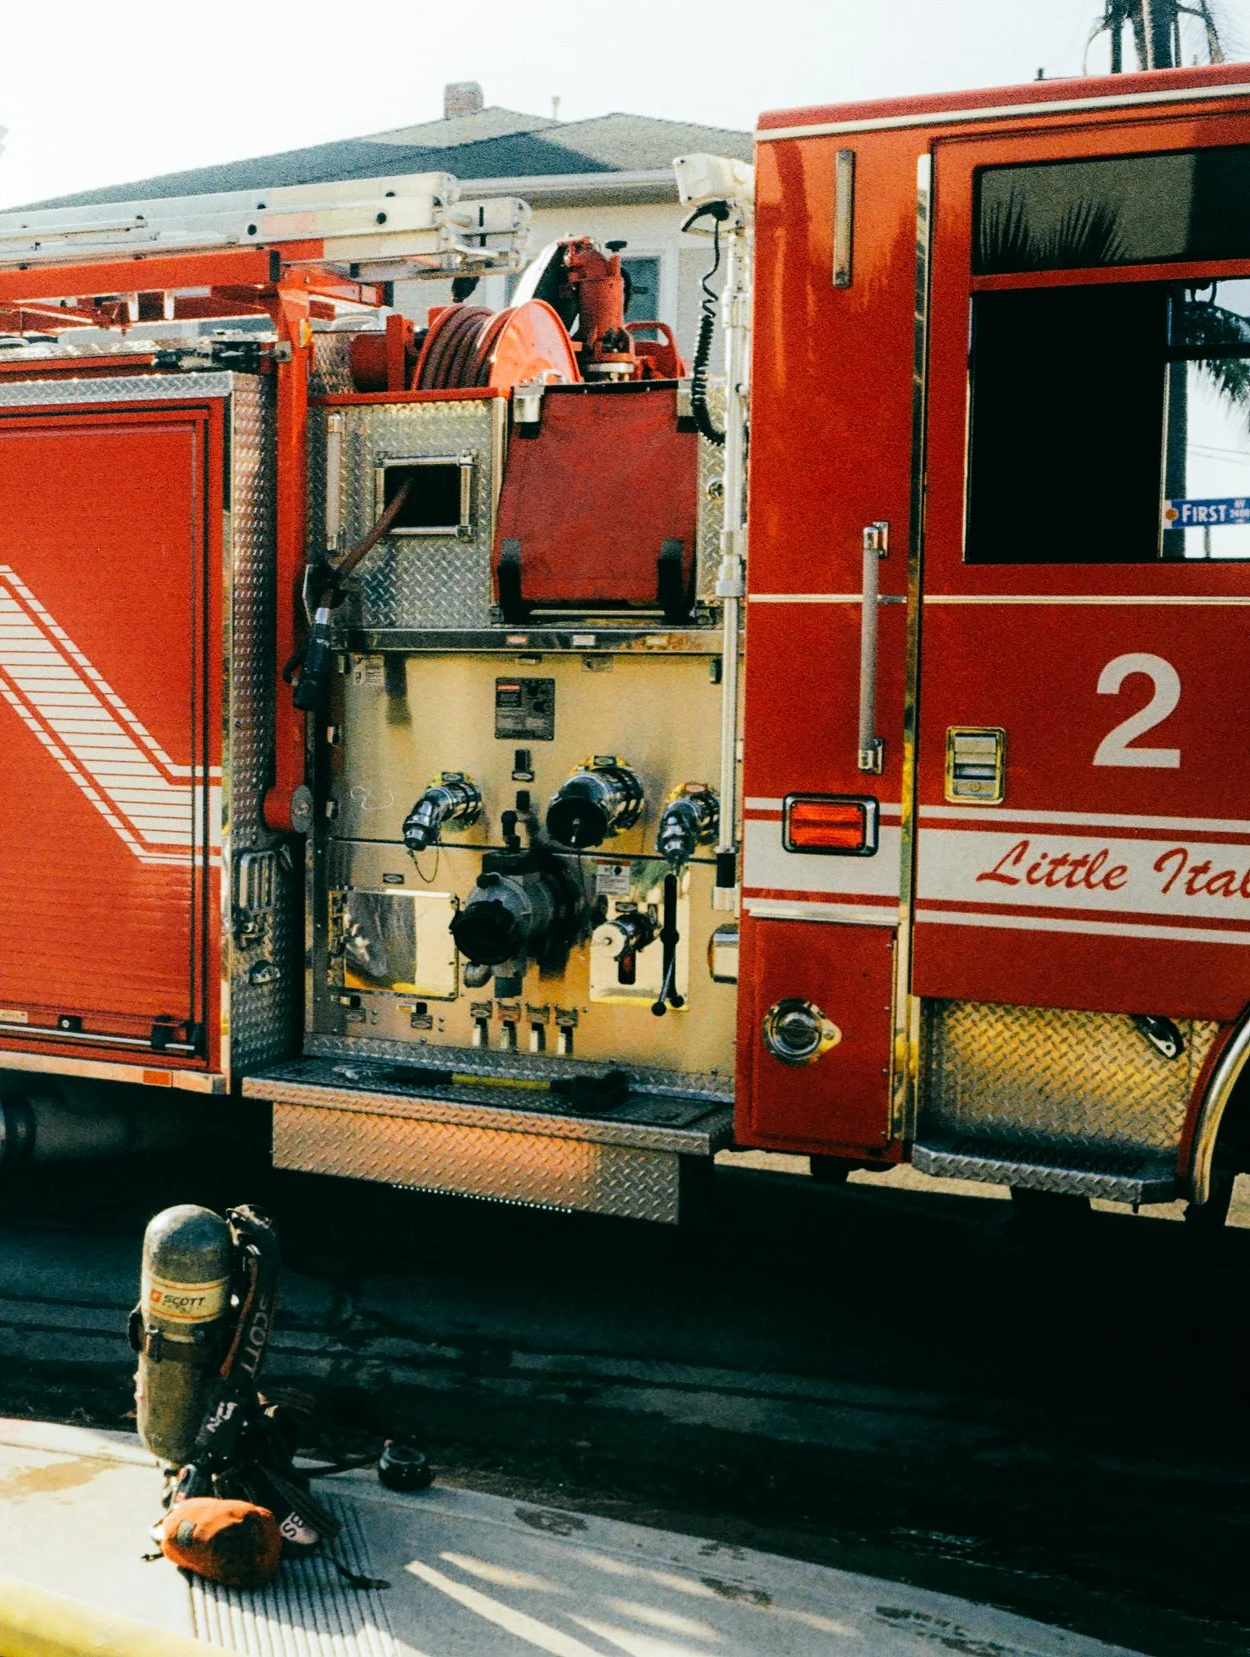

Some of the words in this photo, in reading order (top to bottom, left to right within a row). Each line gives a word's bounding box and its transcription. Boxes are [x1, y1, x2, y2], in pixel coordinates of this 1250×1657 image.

[1182, 504, 1227, 522] FIRST
[1092, 652, 1182, 769] 2
[975, 839, 1129, 891] Little
[163, 1294, 205, 1307] SCOTT
